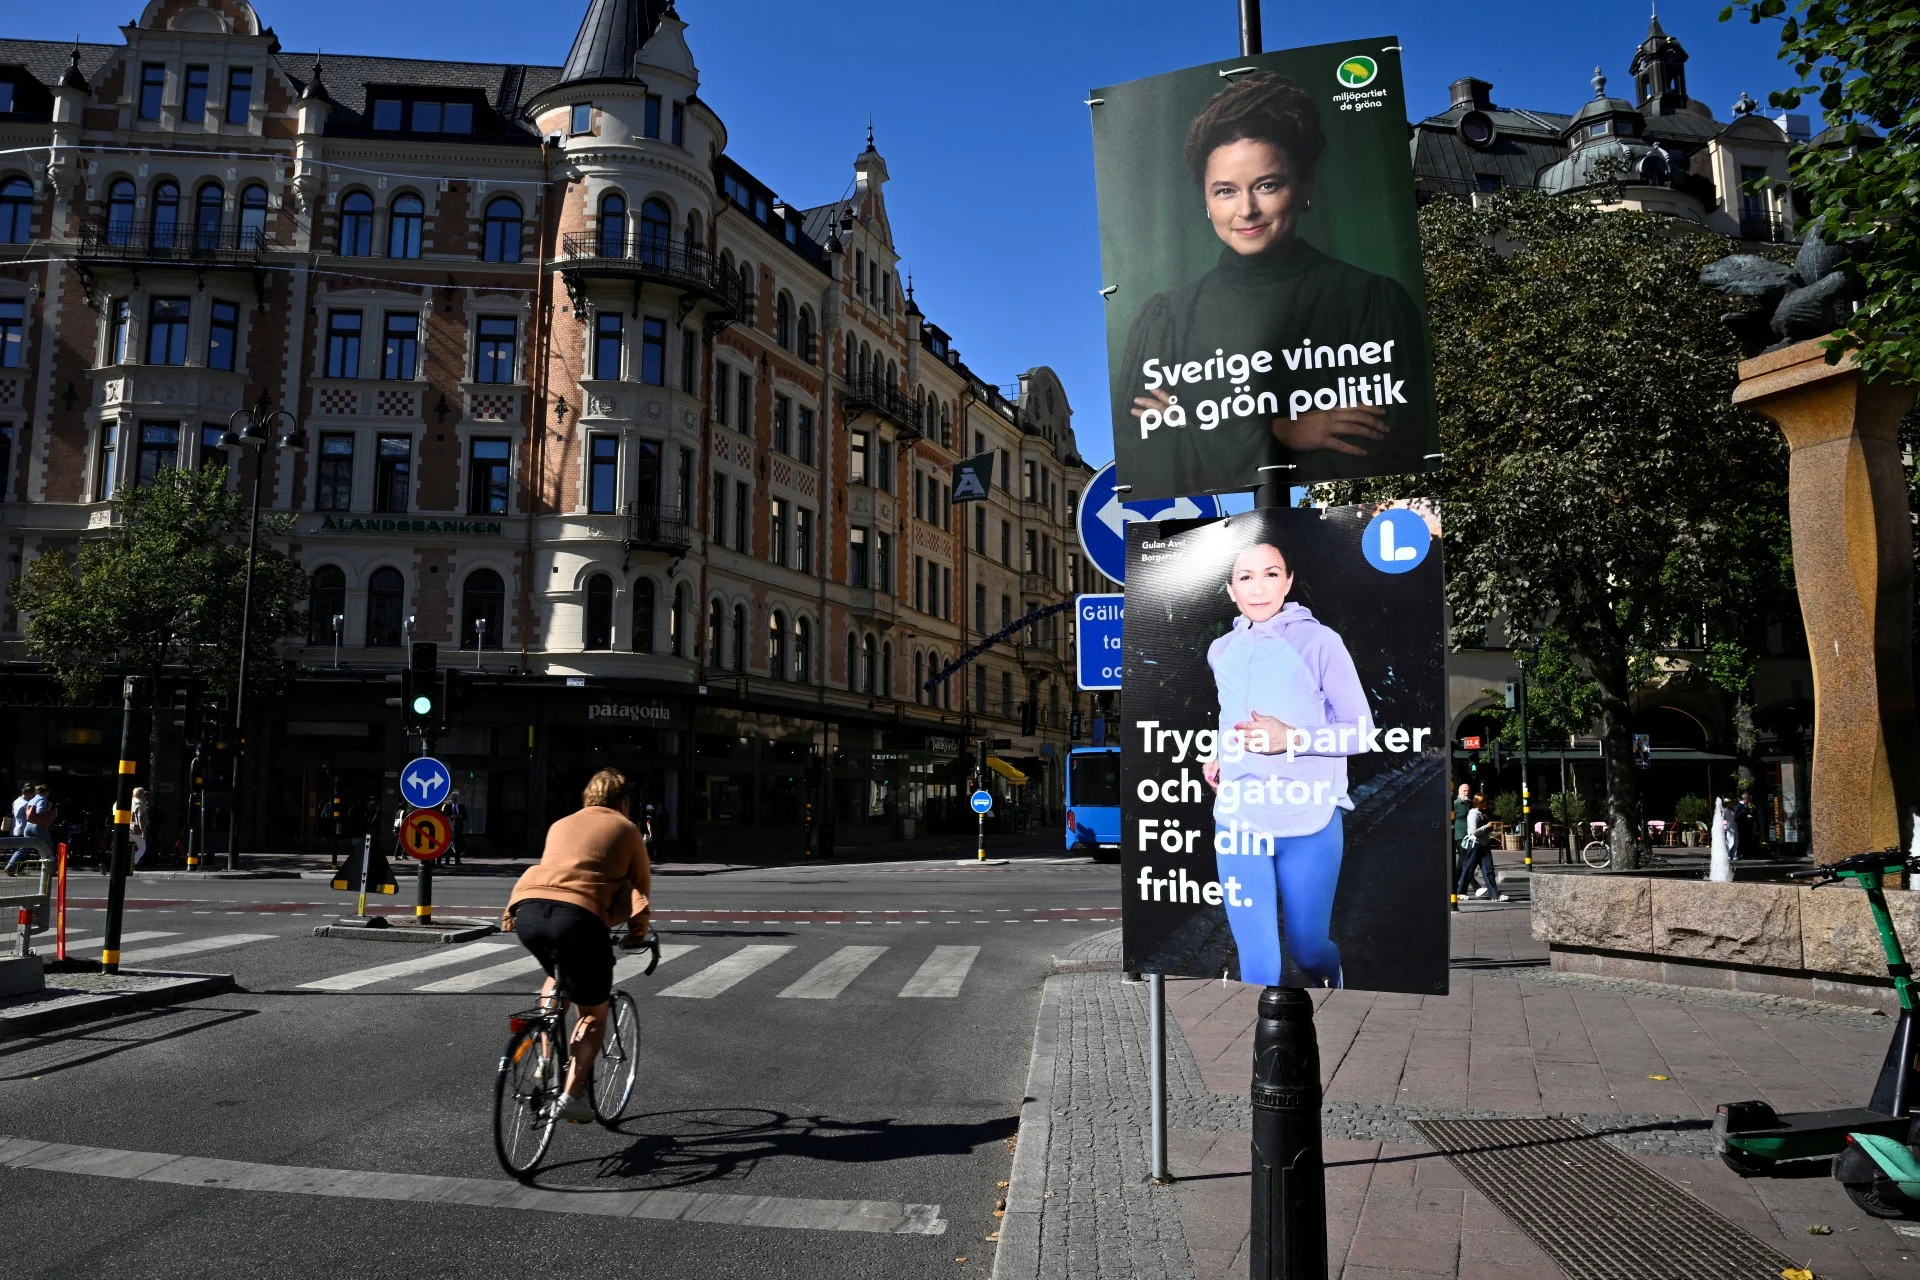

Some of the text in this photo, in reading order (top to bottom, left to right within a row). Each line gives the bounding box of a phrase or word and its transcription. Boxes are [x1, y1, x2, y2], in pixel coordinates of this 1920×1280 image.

[1333, 88, 1387, 102] miljöpartiet
[1340, 100, 1382, 112] de gröna
[1143, 338, 1395, 390] Sverige vinner
[1140, 372, 1408, 440] på grön politik
[321, 515, 503, 534] ÅLANDSBANKEN
[1142, 540, 1166, 549] Gulan
[1379, 520, 1417, 562] L
[1103, 634, 1121, 649] ta
[1101, 666, 1122, 679] oc
[587, 703, 670, 721] patagonia
[1136, 715, 1431, 763] Trygga parker
[1136, 768, 1338, 813] och gator.
[1138, 819, 1275, 857] För din
[1137, 866, 1254, 908] frihet.
